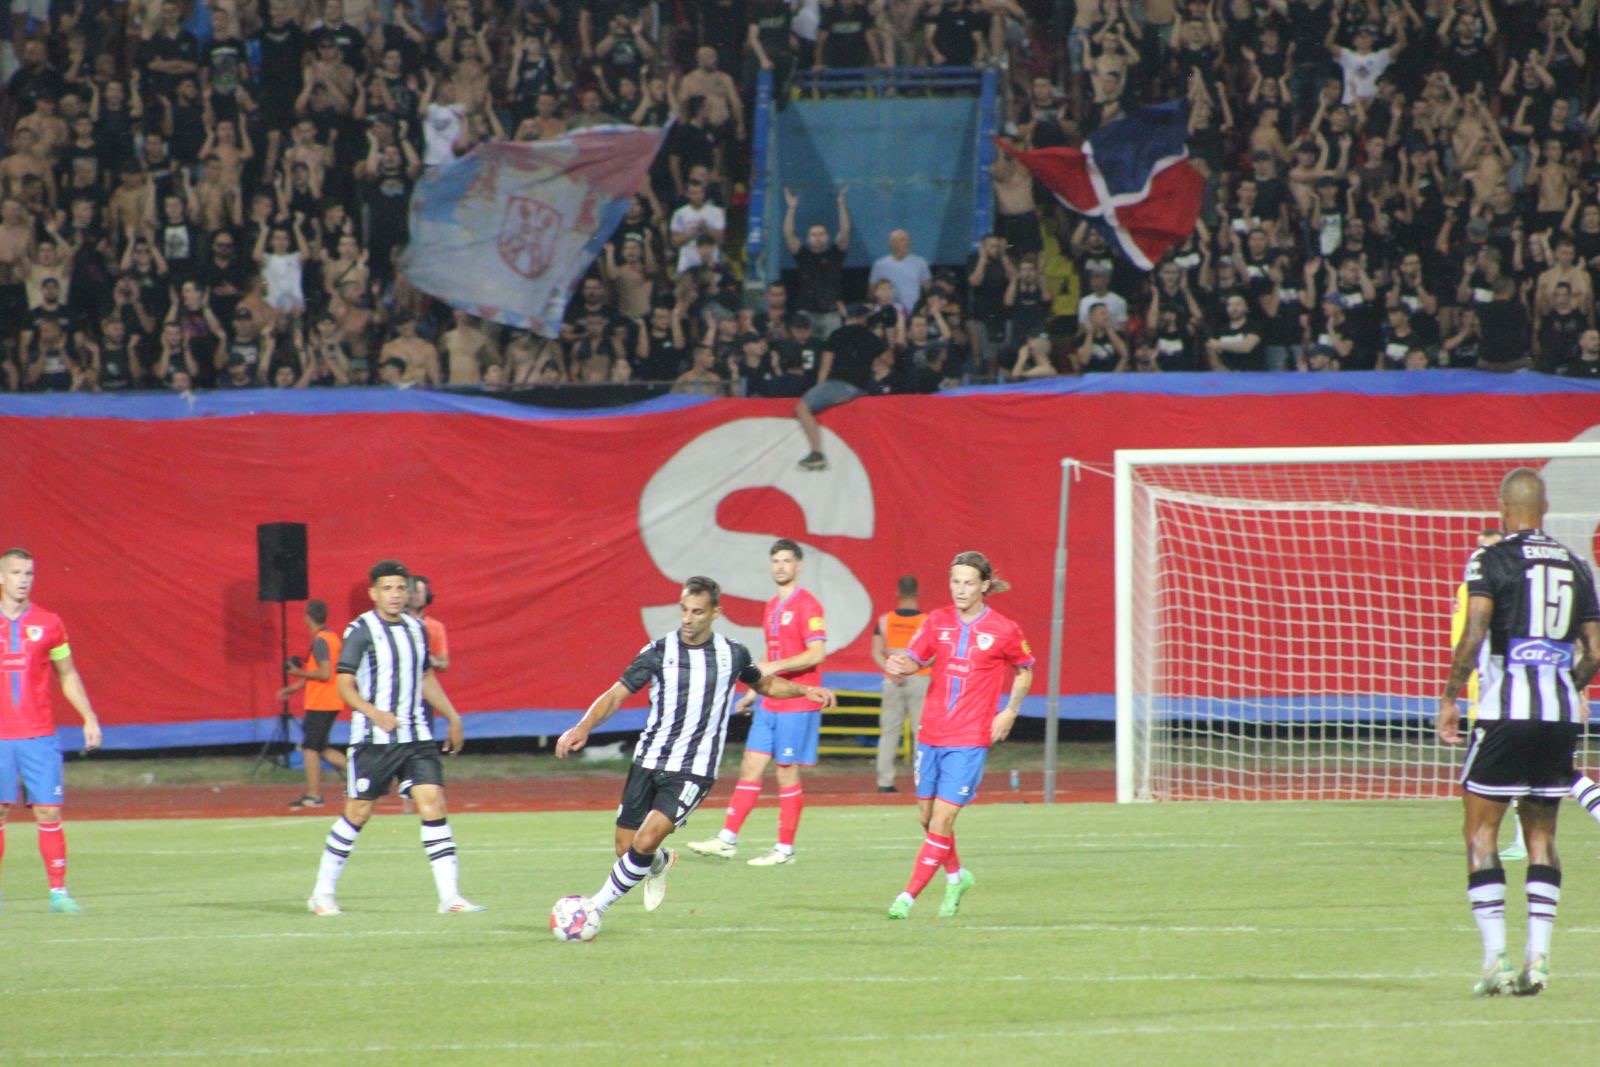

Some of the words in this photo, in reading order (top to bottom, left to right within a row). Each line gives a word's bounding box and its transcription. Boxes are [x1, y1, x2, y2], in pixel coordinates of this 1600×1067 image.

[639, 417, 875, 660] S
[1522, 545, 1569, 561] EKONG
[1526, 564, 1574, 640] 15
